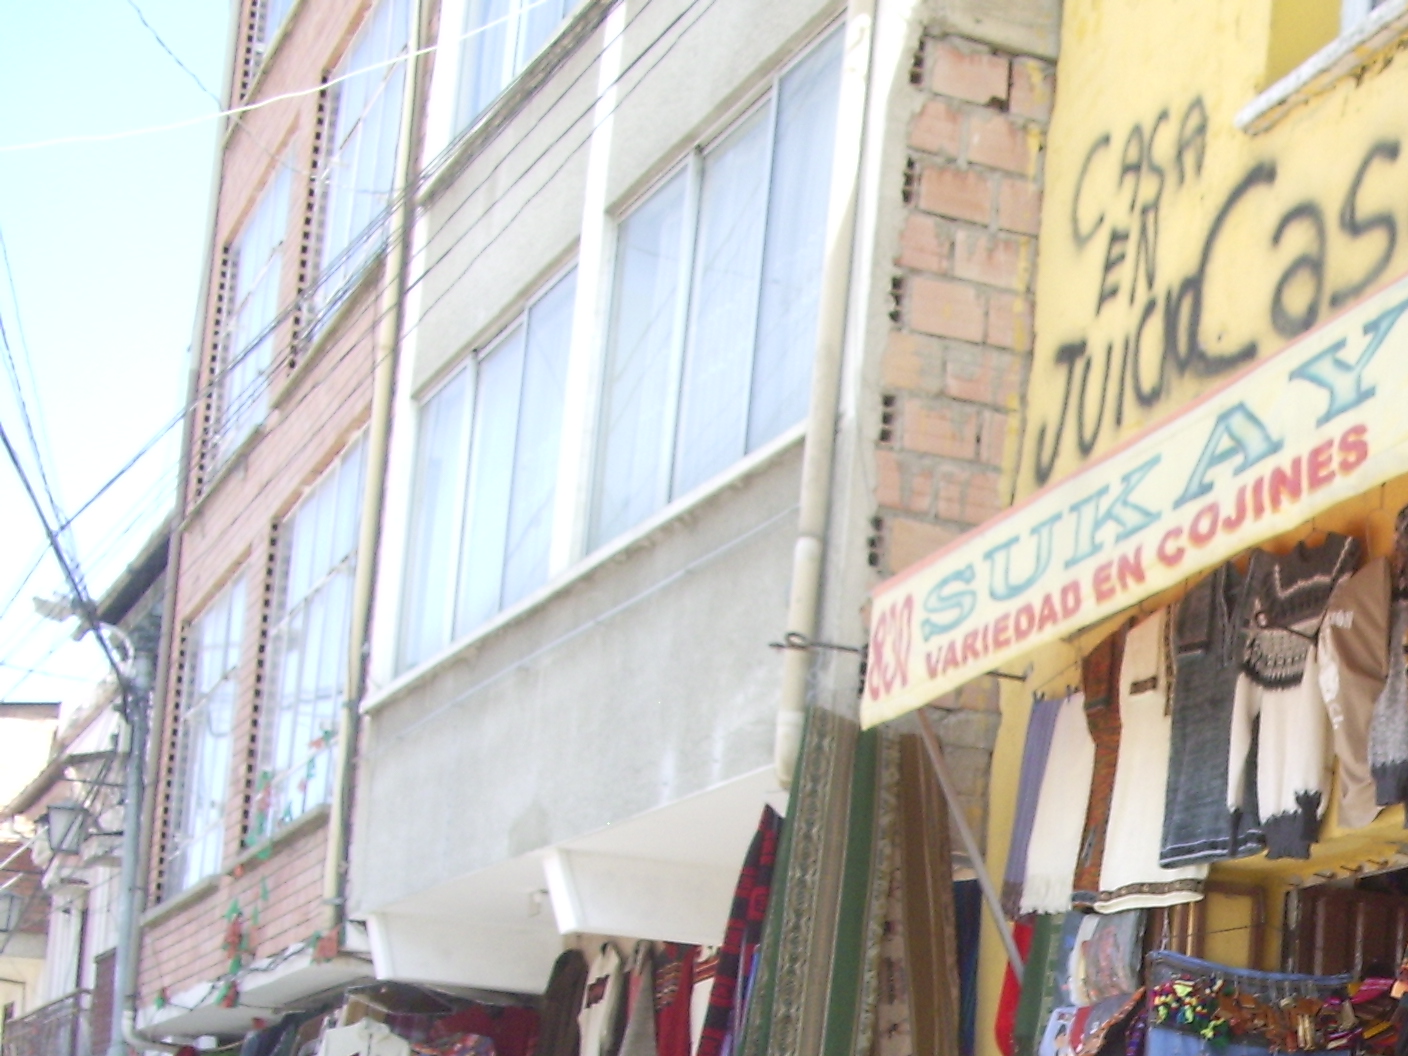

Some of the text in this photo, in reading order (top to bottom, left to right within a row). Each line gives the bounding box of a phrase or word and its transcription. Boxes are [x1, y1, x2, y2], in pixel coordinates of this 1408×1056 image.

[1072, 95, 1208, 246] CASA
[1097, 204, 1159, 316] EN
[925, 423, 1369, 679] VARIEDAD EN COJINES
